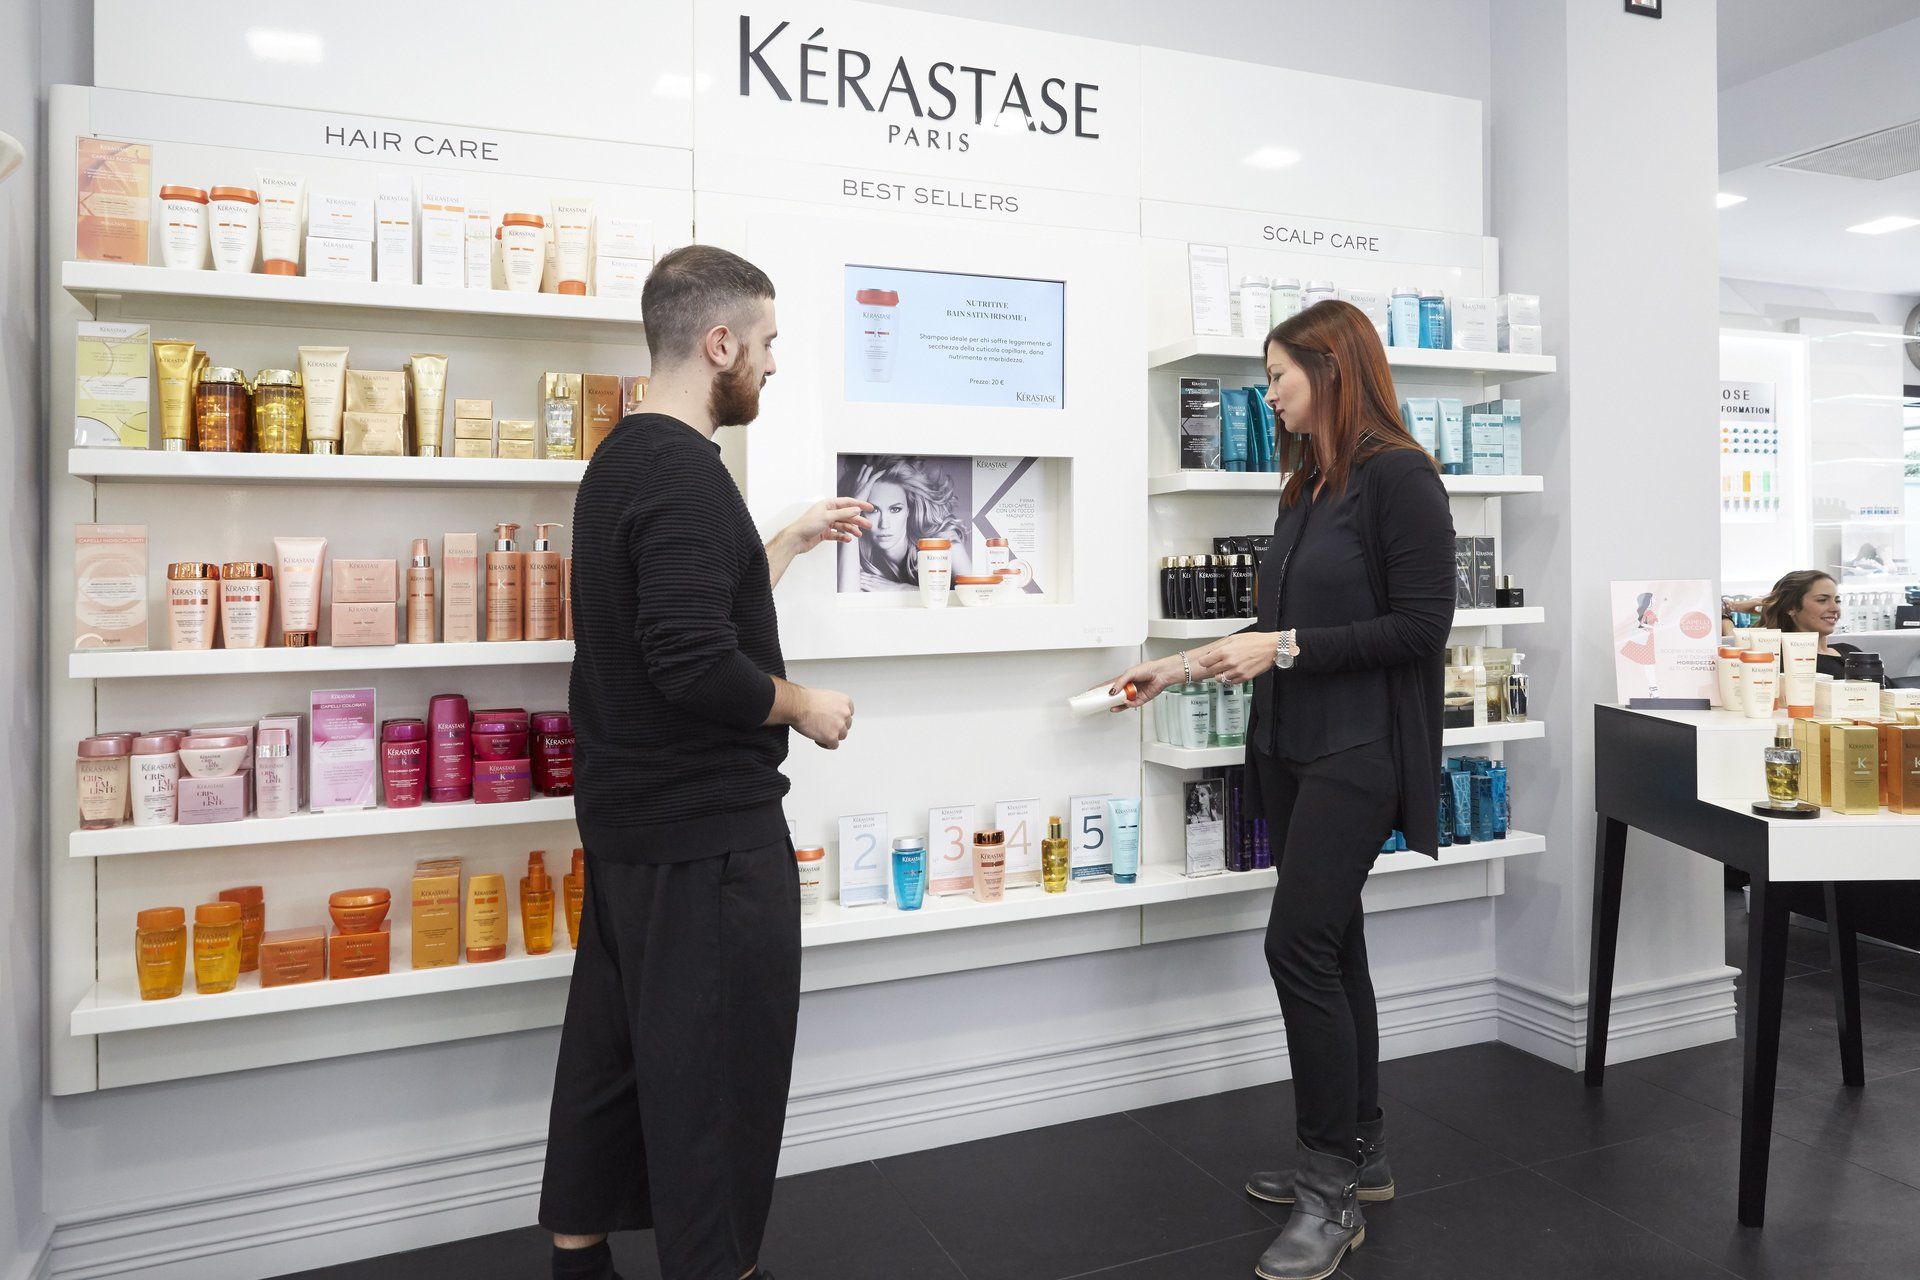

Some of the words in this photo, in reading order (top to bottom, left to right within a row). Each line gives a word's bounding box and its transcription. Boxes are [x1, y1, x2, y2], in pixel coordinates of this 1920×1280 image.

[740, 15, 1099, 139] KÉRASTASE
[326, 126, 402, 152] HAIR
[414, 135, 499, 161] CARE
[888, 125, 970, 152] PARIS
[843, 179, 906, 201] BEST
[914, 187, 1020, 212] SELLERS
[1263, 225, 1324, 246] SCALP
[1330, 233, 1380, 252] CARE
[919, 333, 949, 341] Shampoo
[387, 748, 421, 756] KÉRASTASE
[943, 826, 965, 862] 3
[1007, 820, 1032, 855] 4
[1083, 815, 1104, 850] 5
[854, 833, 877, 870] 2
